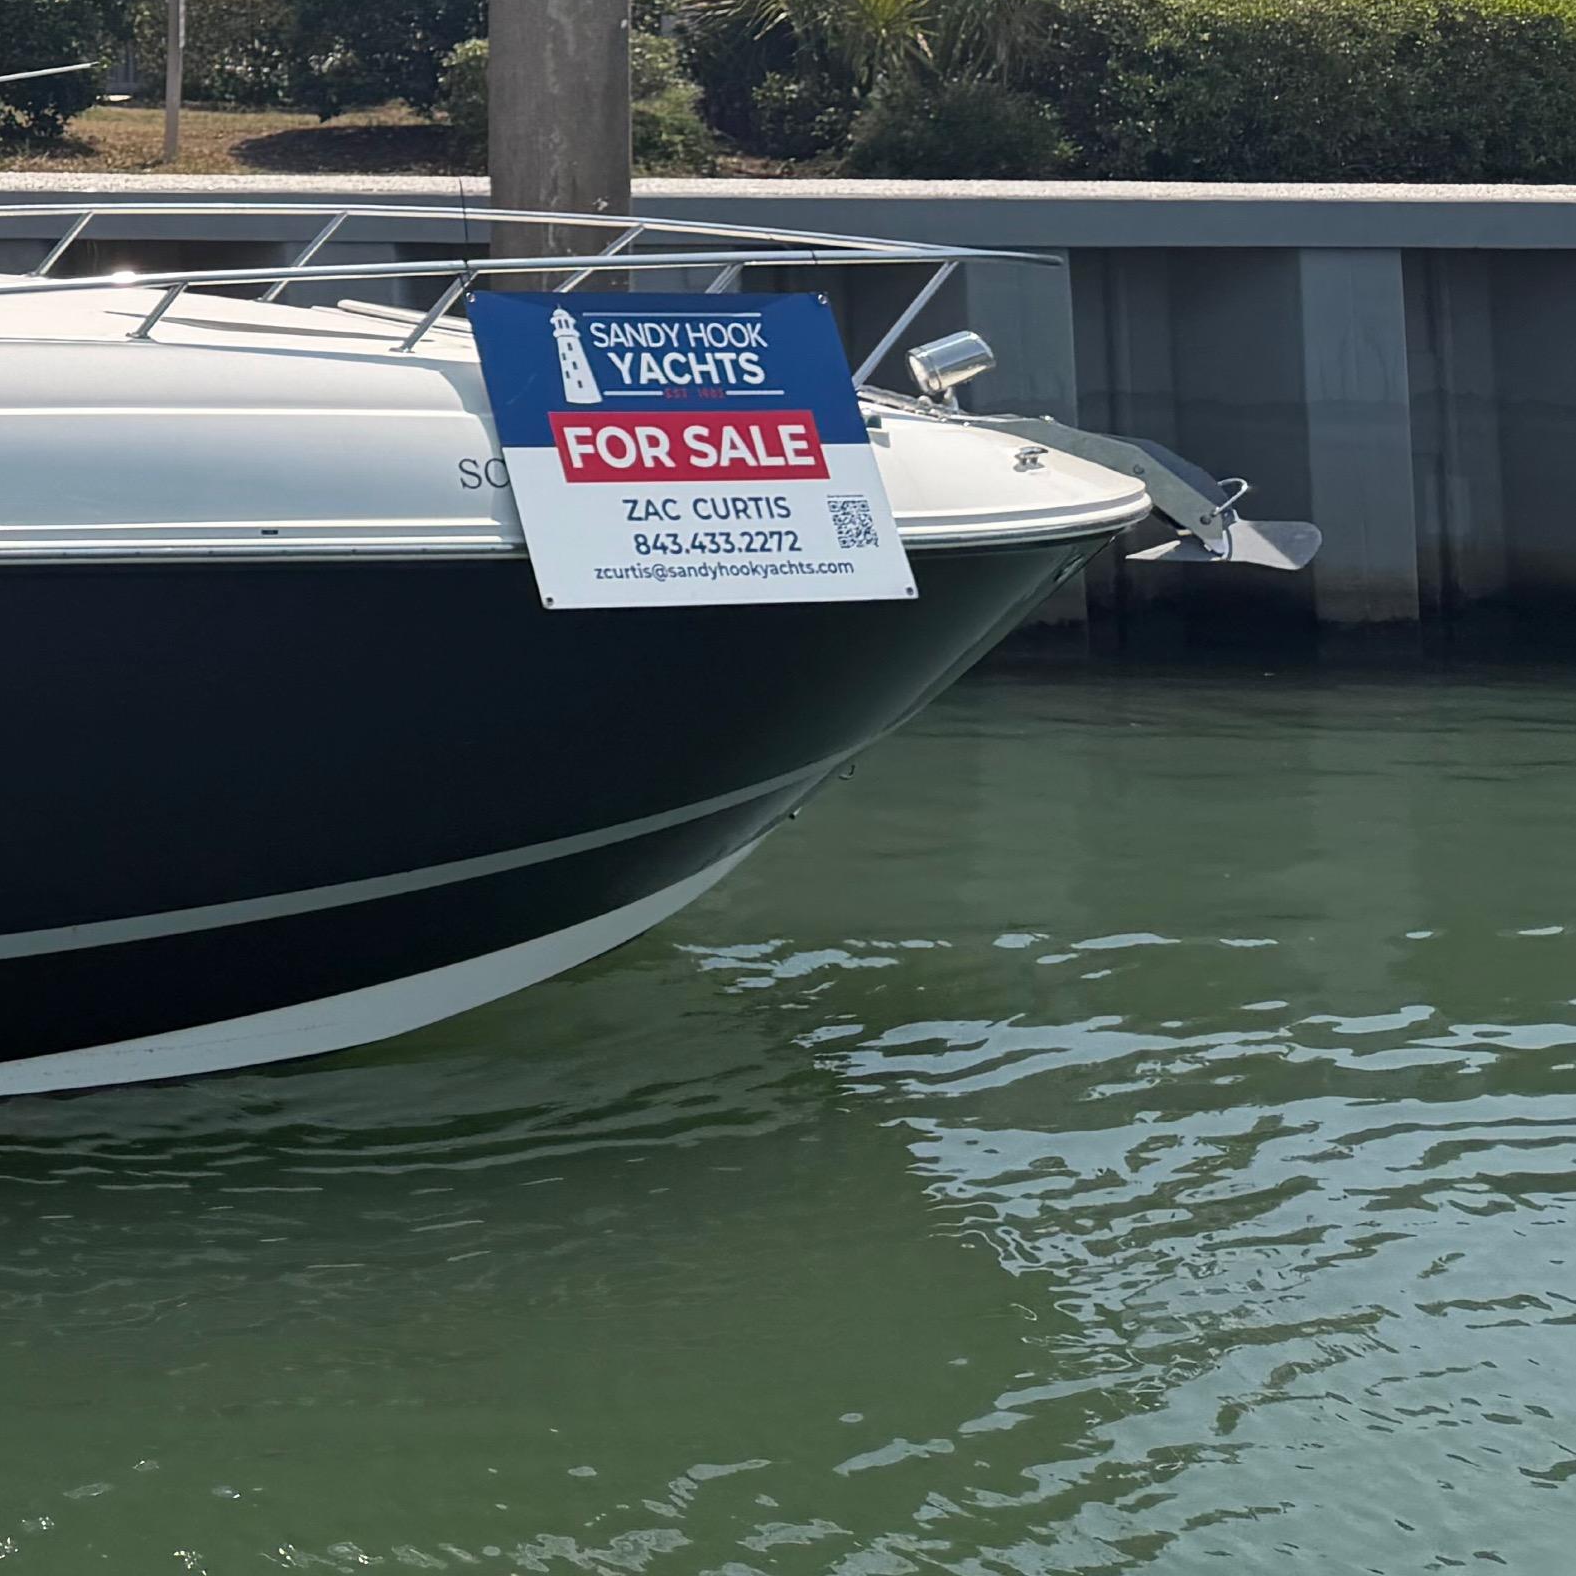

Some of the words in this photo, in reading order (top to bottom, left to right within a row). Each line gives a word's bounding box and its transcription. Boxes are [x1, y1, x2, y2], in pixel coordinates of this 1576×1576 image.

[589, 322, 679, 348] SANDY
[686, 322, 768, 348] HOOK
[607, 352, 766, 385] YACHTS
[562, 426, 676, 469] FOR
[682, 424, 816, 467] SALE
[622, 497, 681, 522] ZAC
[692, 496, 792, 521] CURTIS
[635, 530, 802, 556] 843.433.2272
[594, 559, 855, 581] zcurtis@sandyhookyachts.com
